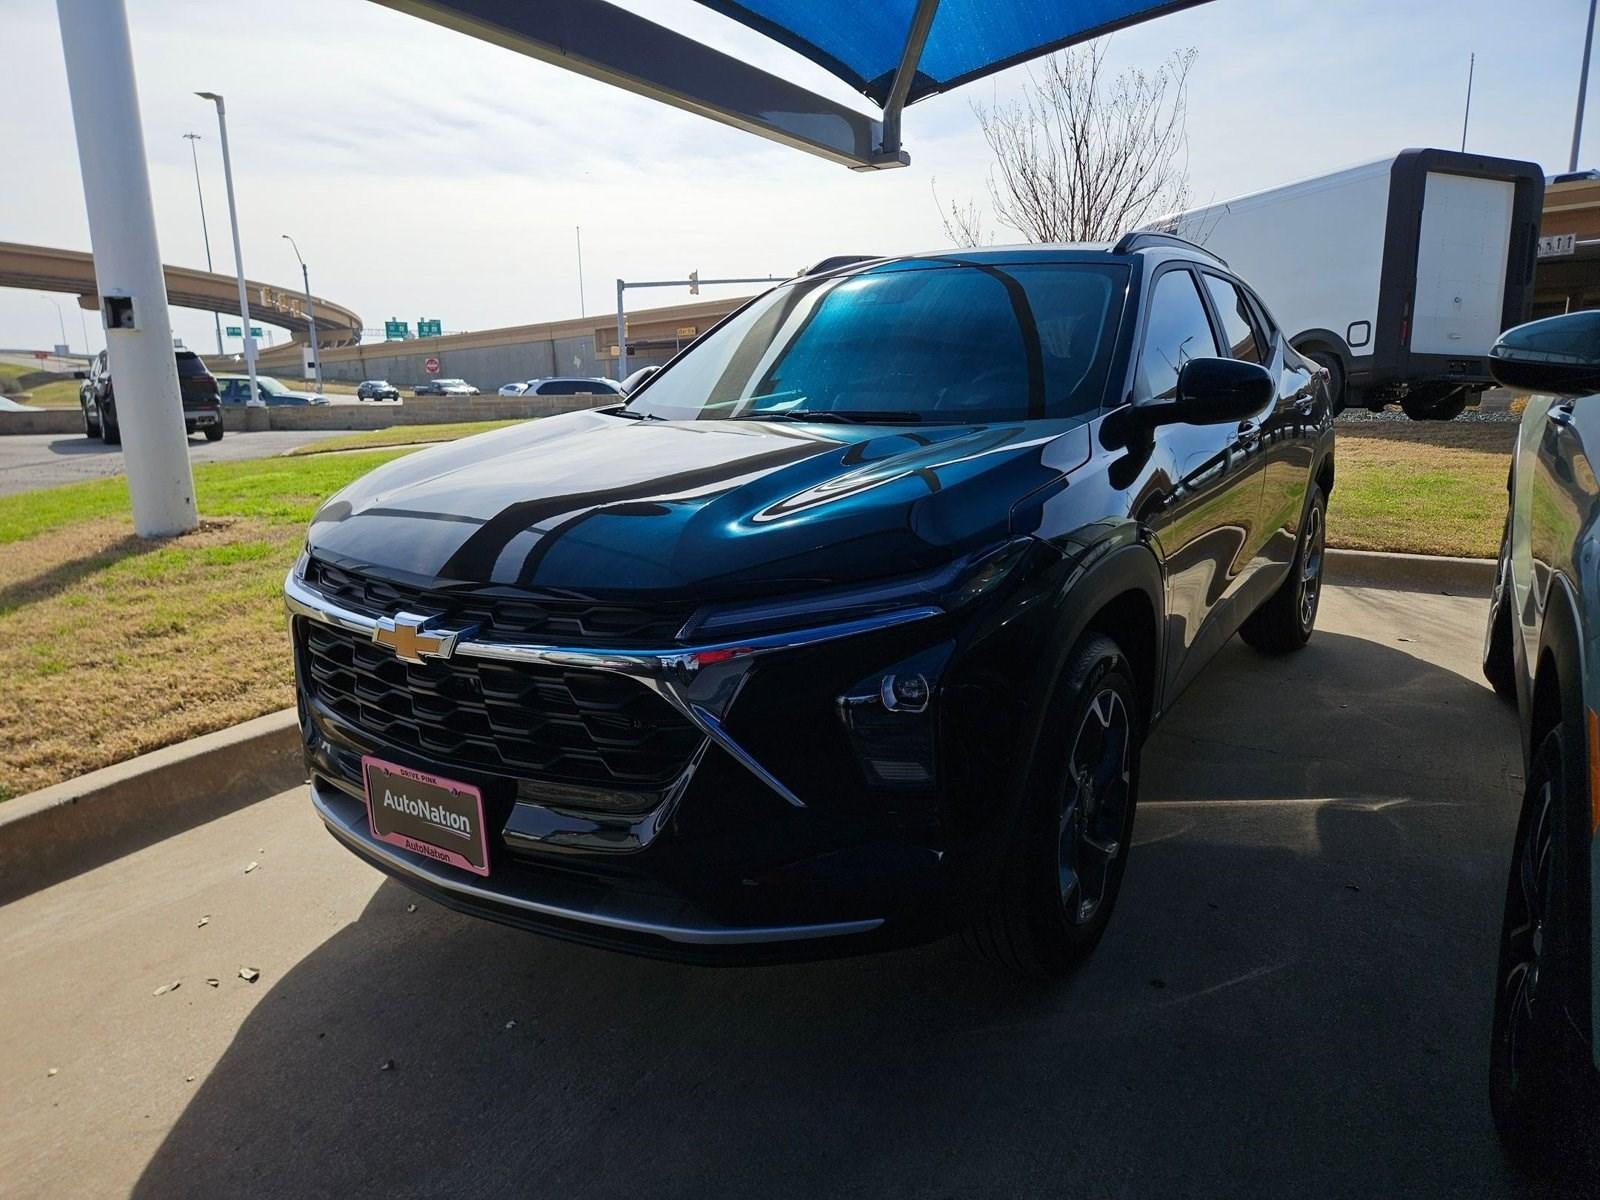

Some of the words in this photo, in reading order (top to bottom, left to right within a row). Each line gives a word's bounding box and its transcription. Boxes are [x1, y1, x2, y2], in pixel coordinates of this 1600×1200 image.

[400, 768, 420, 780] DRIVE
[421, 774, 438, 785] PINK
[383, 789, 471, 832] AutoNation
[405, 839, 451, 863] AutoNation
